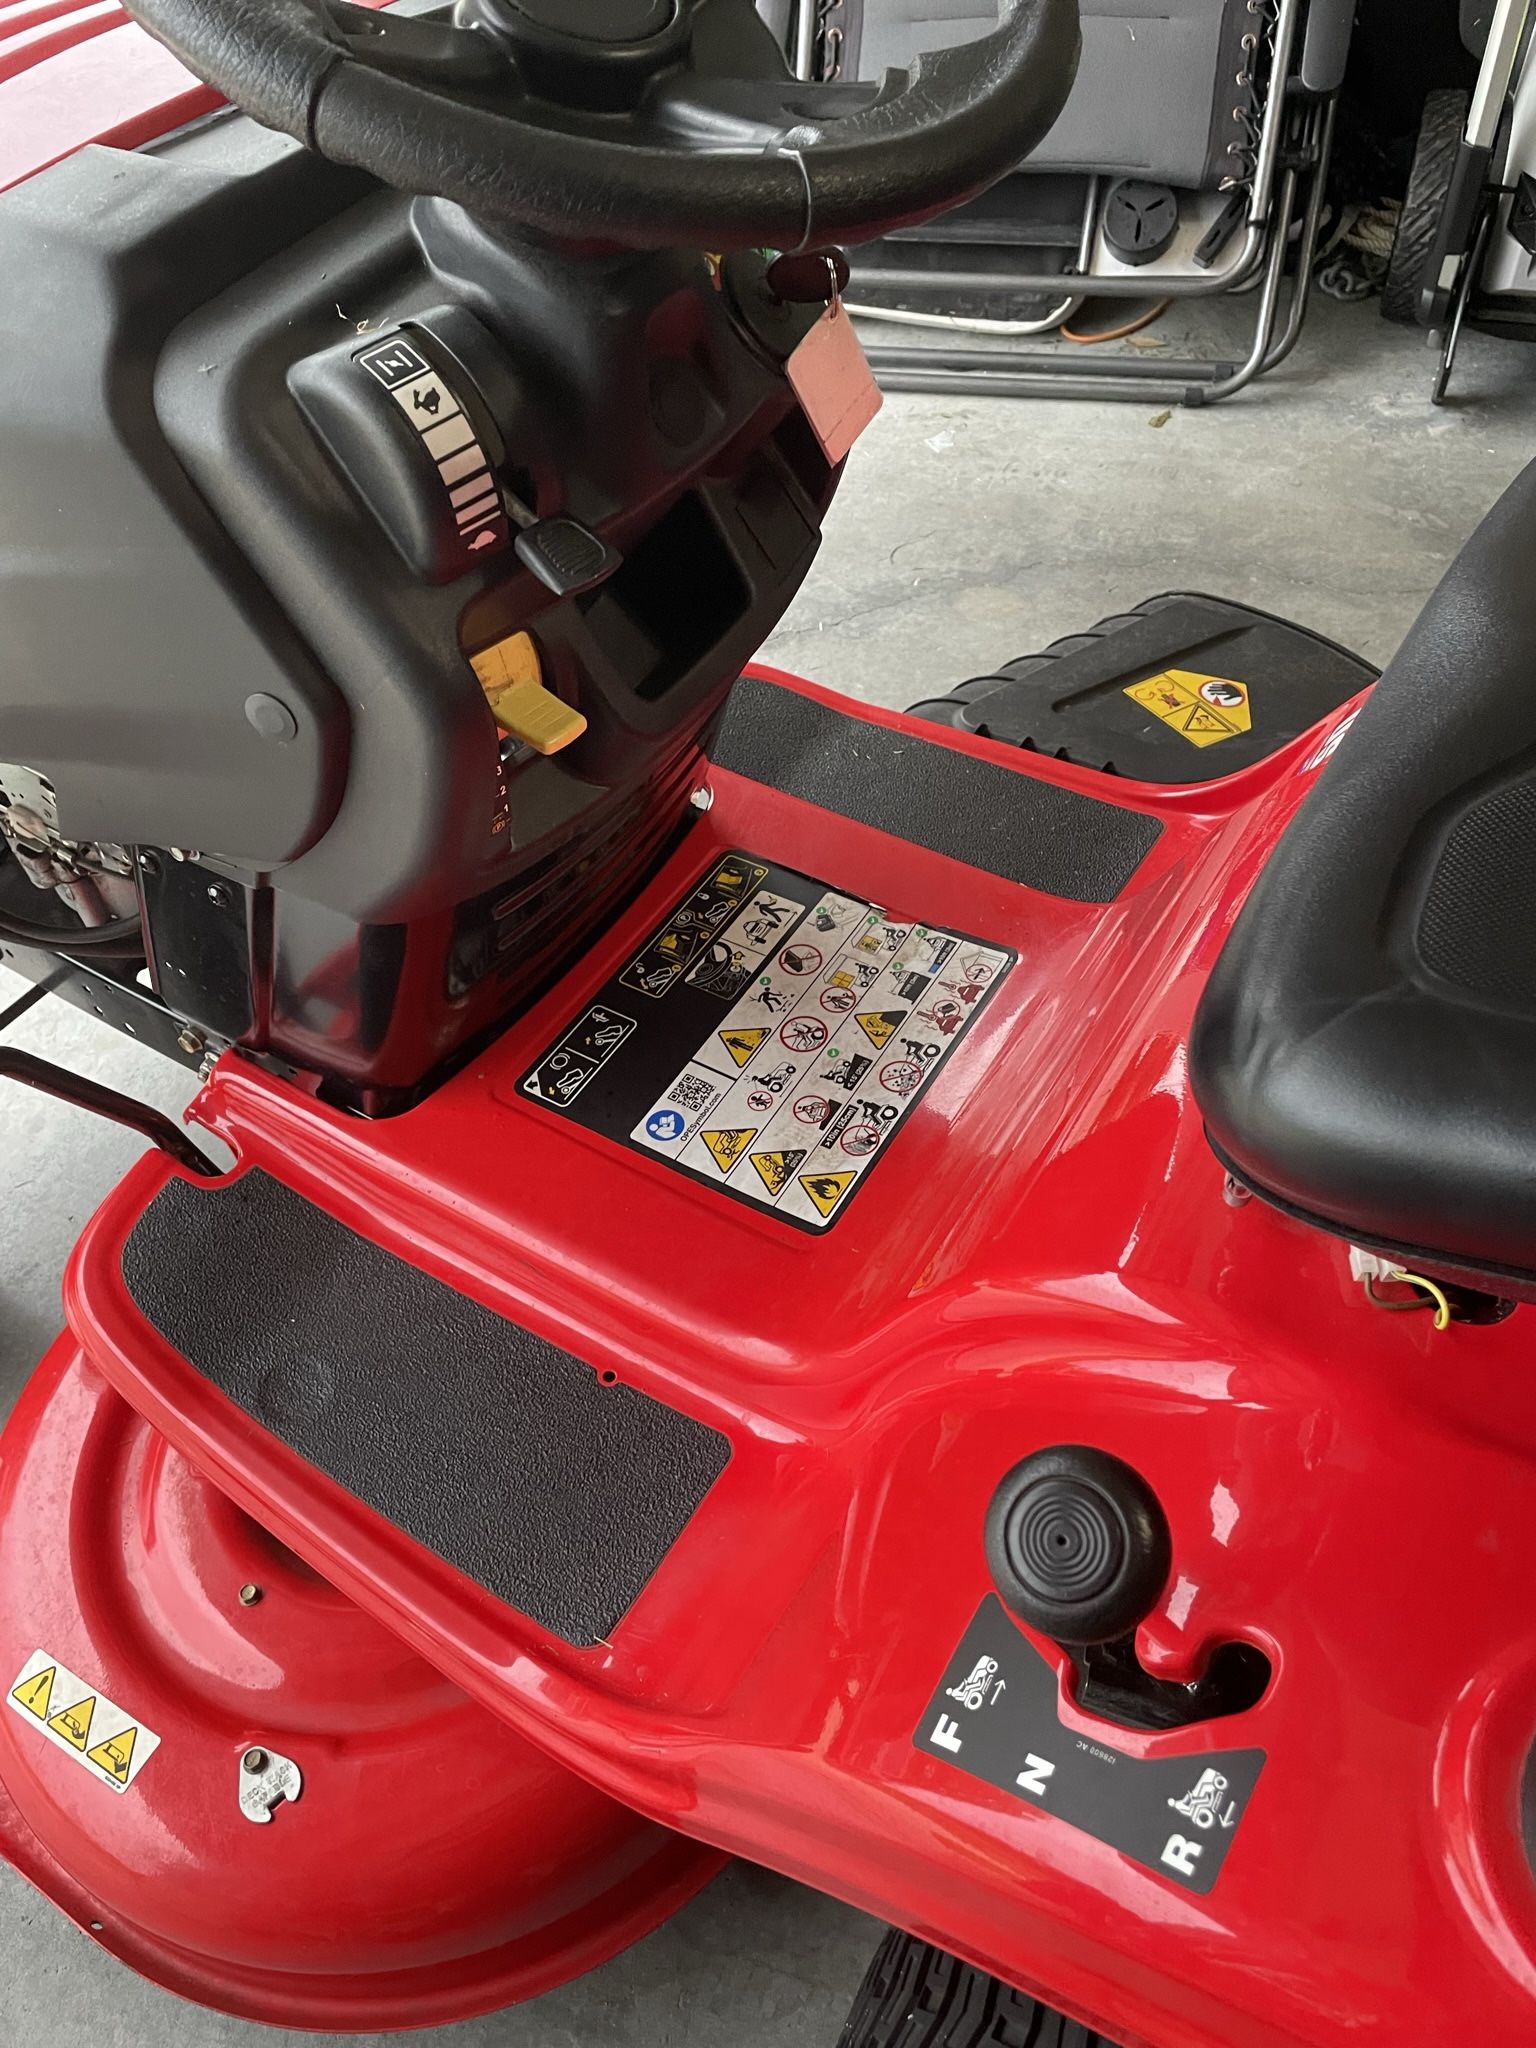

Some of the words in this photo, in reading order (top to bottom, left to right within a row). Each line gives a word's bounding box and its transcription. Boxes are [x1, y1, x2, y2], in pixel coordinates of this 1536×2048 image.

[496, 765, 502, 776] 3
[500, 785, 507, 796] 2
[503, 803, 509, 813] 1
[680, 1092, 722, 1142] OPESymbol.com
[824, 1127, 841, 1147] >10in
[836, 1106, 858, 1129] (25cm)
[930, 1713, 963, 1753] F
[1075, 1740, 1089, 1751] AC
[1016, 1752, 1056, 1796] N
[1160, 1833, 1204, 1876] R
